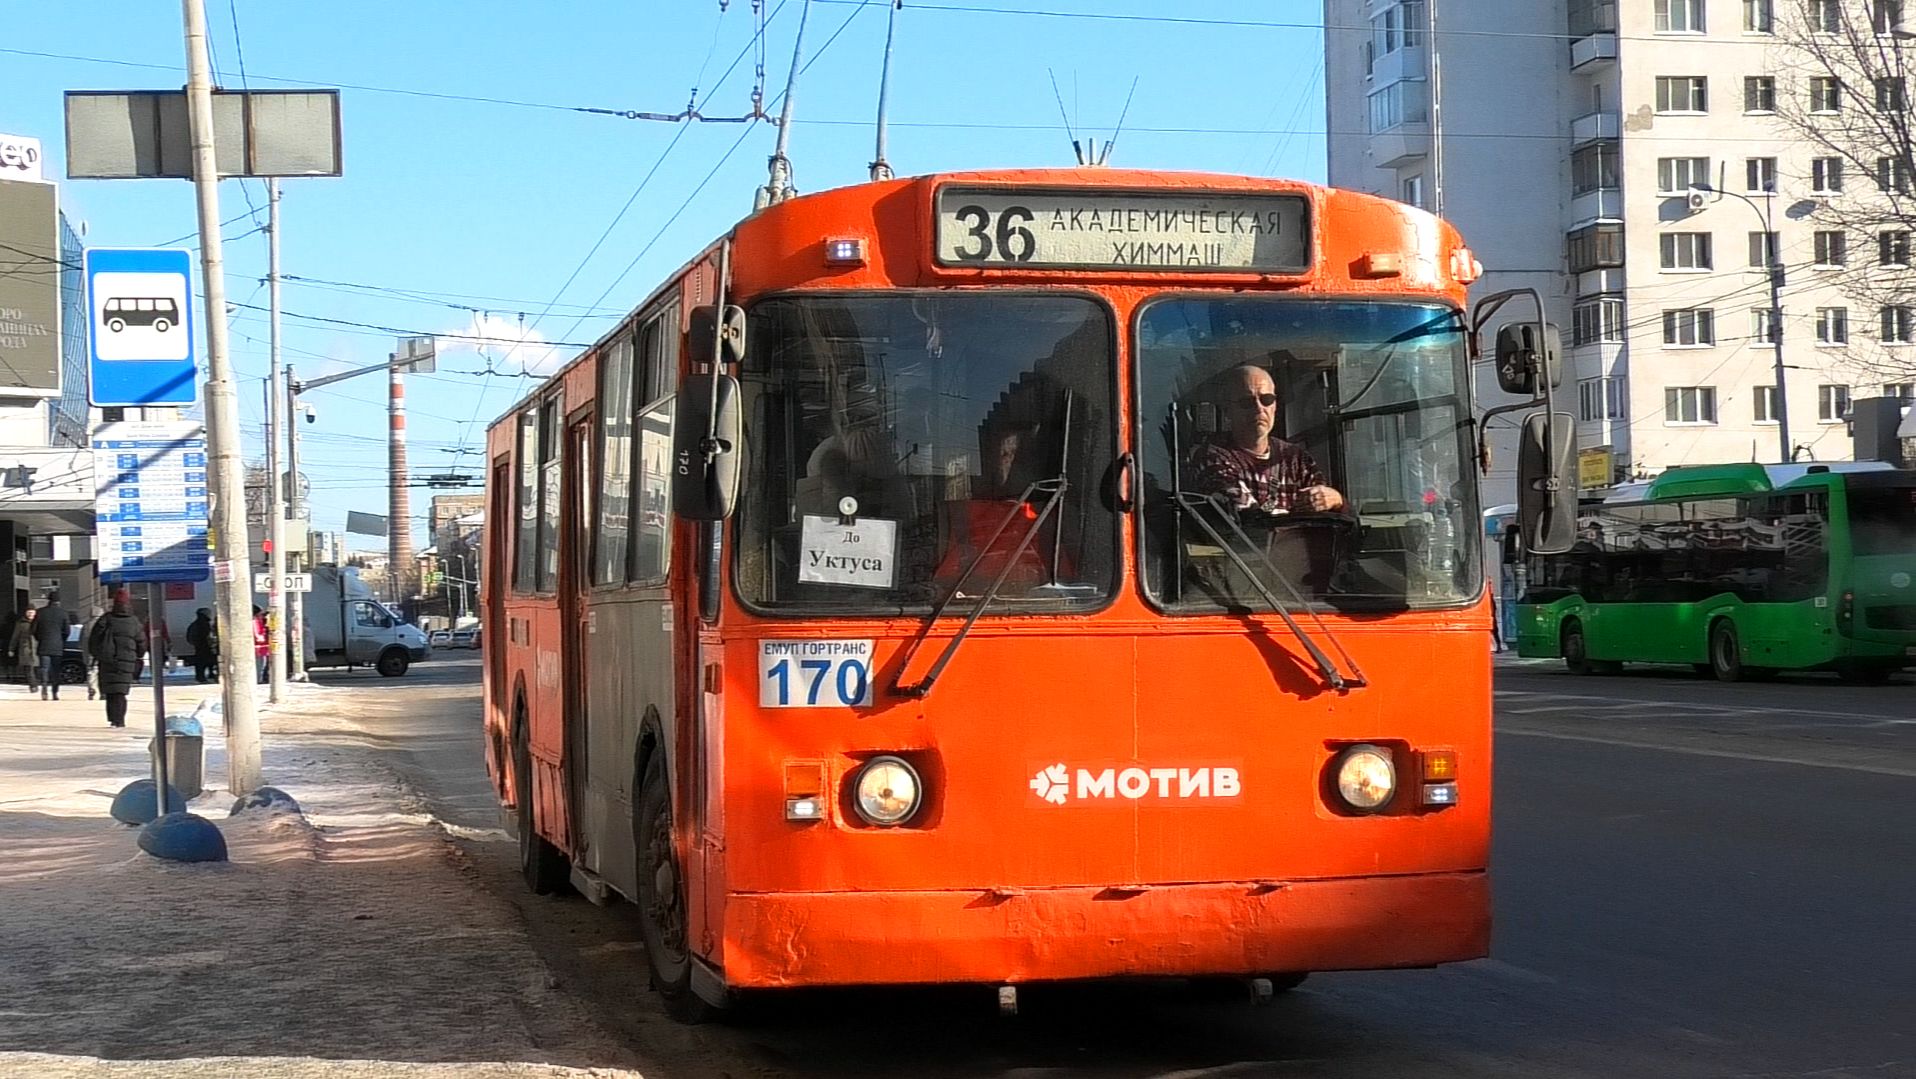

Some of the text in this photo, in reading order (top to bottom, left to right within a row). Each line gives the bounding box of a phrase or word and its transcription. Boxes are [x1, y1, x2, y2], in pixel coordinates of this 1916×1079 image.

[954, 205, 1281, 263] 36 АКАДЕМИЧЕСКАЯ
[1112, 242, 1223, 267] ХИММАШ
[842, 531, 860, 543] До
[809, 550, 882, 574] Уктуса
[764, 643, 866, 655] ЕМУП ГОРТРАНС
[768, 659, 867, 705] 170
[1077, 767, 1241, 799] МОТИВ
